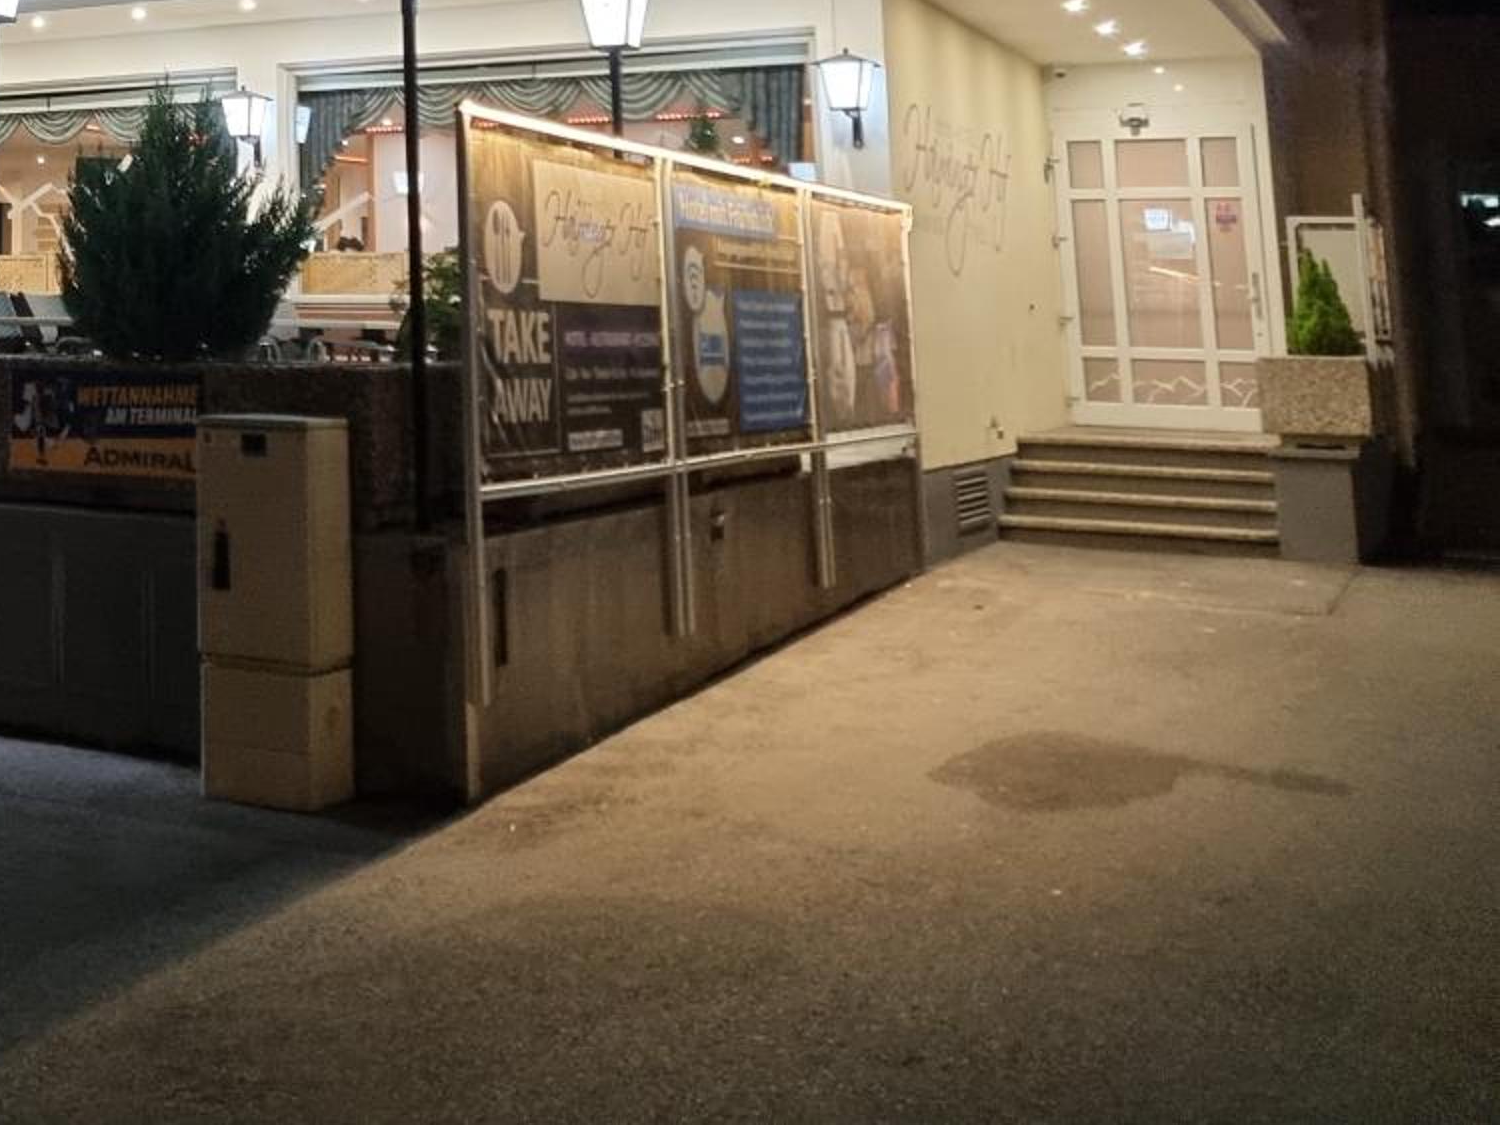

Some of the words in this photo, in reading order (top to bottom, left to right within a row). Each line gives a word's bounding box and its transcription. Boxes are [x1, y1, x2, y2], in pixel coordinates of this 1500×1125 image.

[487, 309, 552, 364] TAKE
[493, 378, 551, 424] AWAY
[84, 445, 196, 473] ADMIRAL
